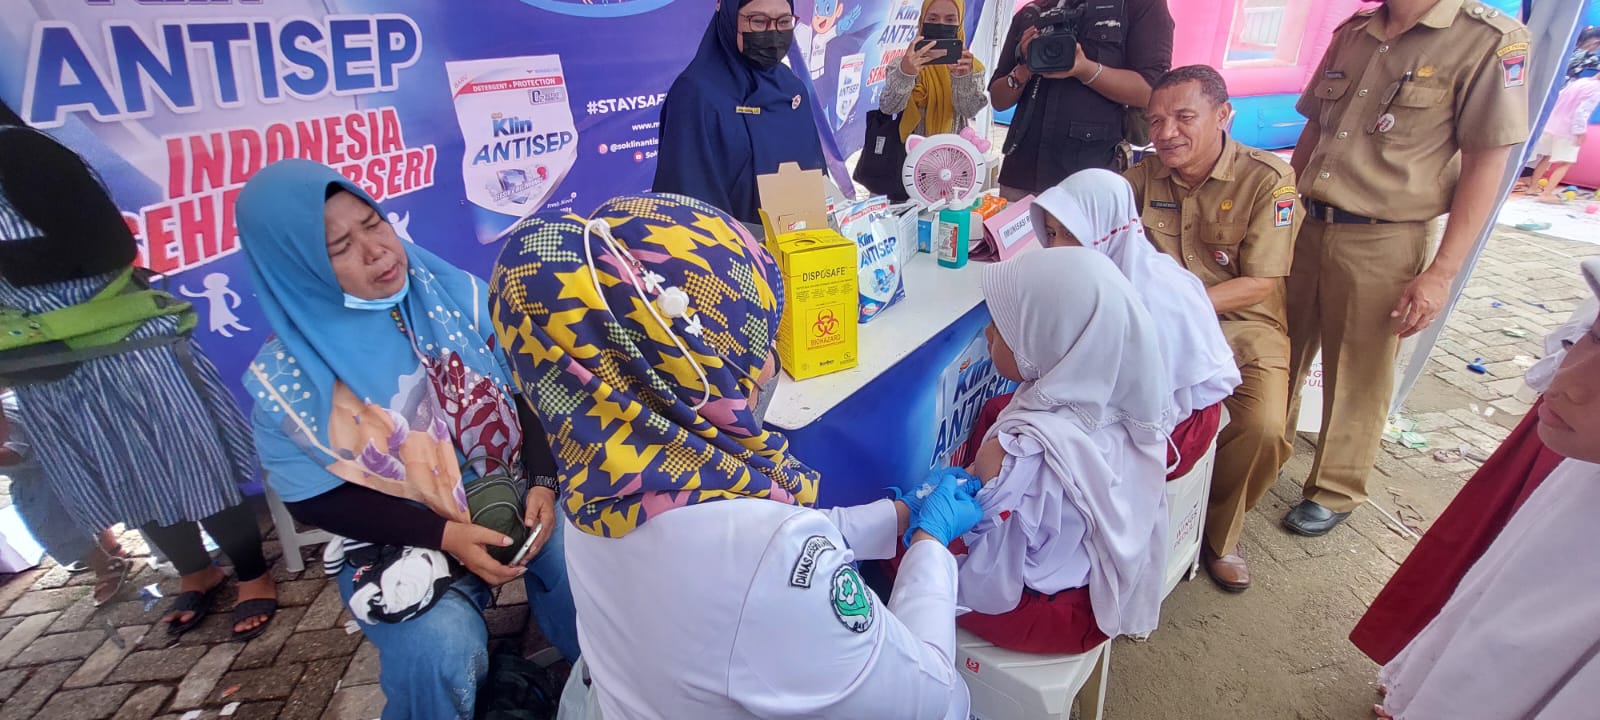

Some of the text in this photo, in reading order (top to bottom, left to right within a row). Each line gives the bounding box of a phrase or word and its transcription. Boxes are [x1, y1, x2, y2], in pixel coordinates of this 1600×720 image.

[877, 24, 919, 45] ANTIS
[27, 16, 419, 125] ANTISEP
[513, 77, 556, 88] PROTECTION
[586, 93, 668, 115] #STAYSAF
[493, 116, 532, 137] Klin
[165, 108, 404, 200] INDONESIA
[472, 130, 574, 166] ANTISEP
[857, 233, 874, 248] Klin
[802, 266, 846, 282] DISPOSAFE
[794, 557, 814, 585] DINAS
